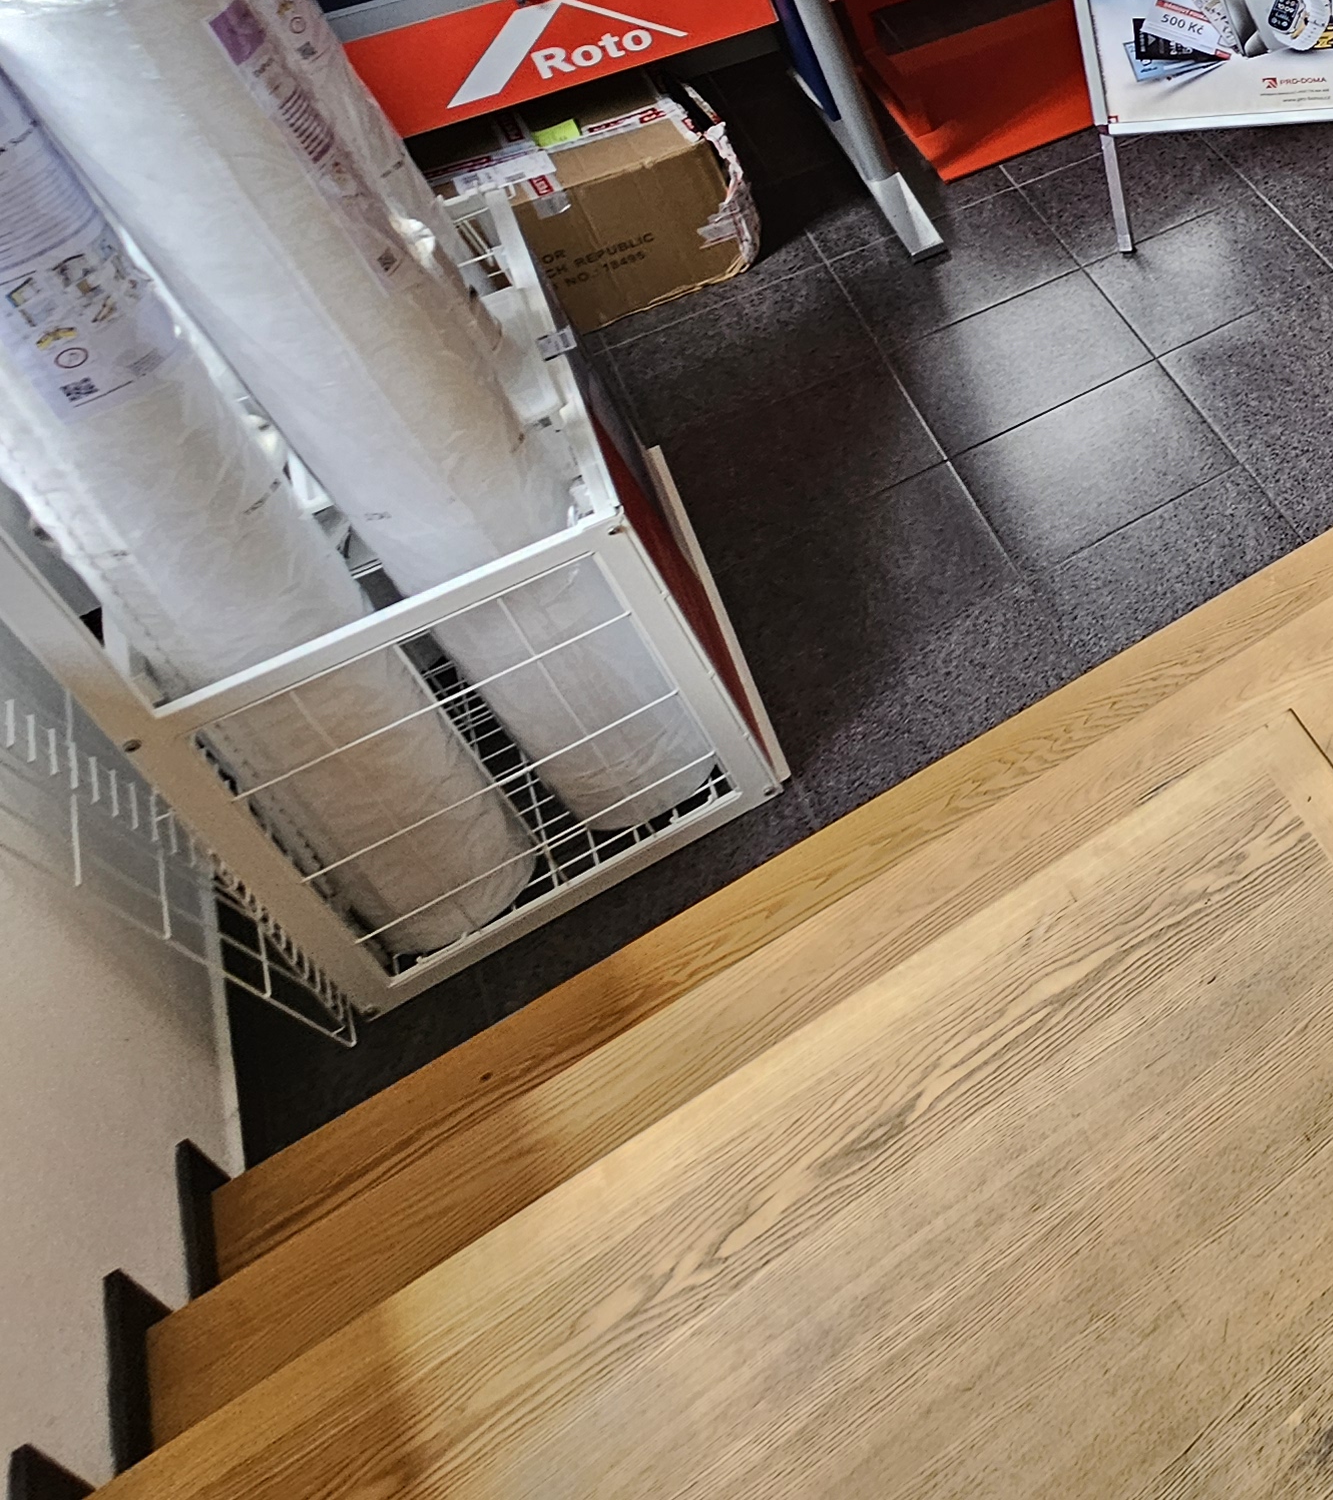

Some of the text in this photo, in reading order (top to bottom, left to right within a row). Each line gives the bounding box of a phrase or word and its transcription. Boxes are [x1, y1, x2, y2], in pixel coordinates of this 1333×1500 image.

[1161, 13, 1204, 35] 500 Kč
[530, 29, 653, 79] Roto
[1279, 77, 1327, 86] PRO-DOMA
[573, 232, 655, 267] REPUBLIC
